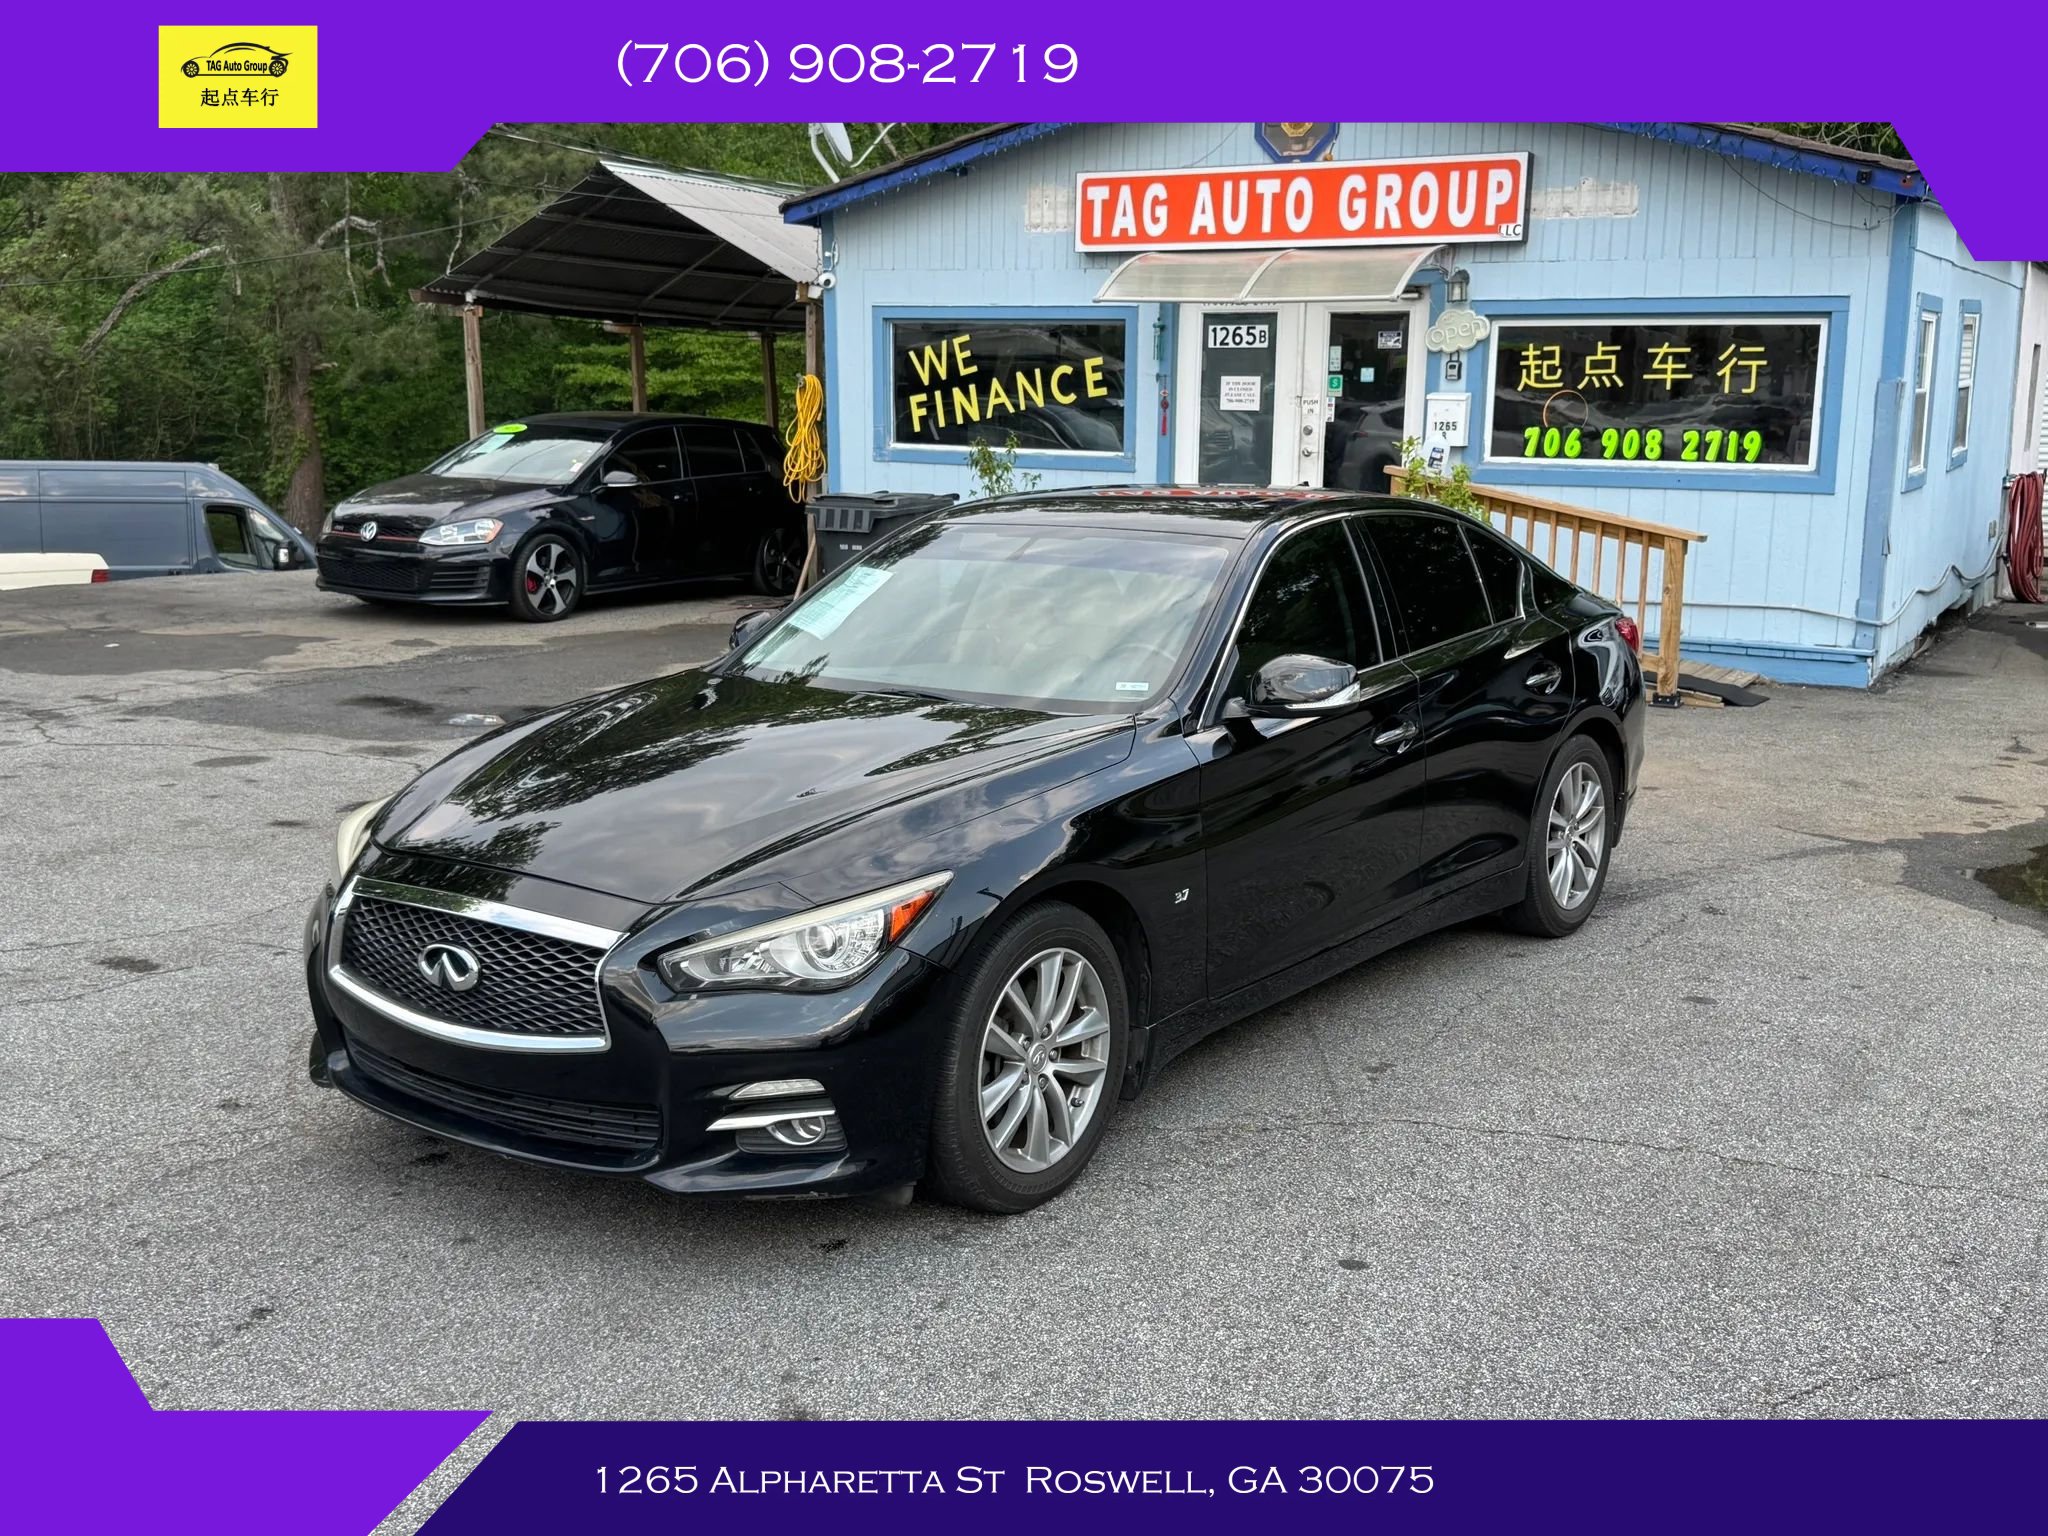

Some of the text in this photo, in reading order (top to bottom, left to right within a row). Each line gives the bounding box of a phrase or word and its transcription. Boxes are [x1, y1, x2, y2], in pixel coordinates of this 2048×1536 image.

[1086, 168, 1514, 238] TAG AUTO GROUP
[1498, 223, 1522, 236] LLC
[908, 333, 979, 386] WE
[1516, 341, 1768, 394] 起点车行
[909, 356, 1108, 433] FINANCE
[1434, 421, 1457, 431] 1265
[1523, 426, 1762, 463] 706 908 2719
